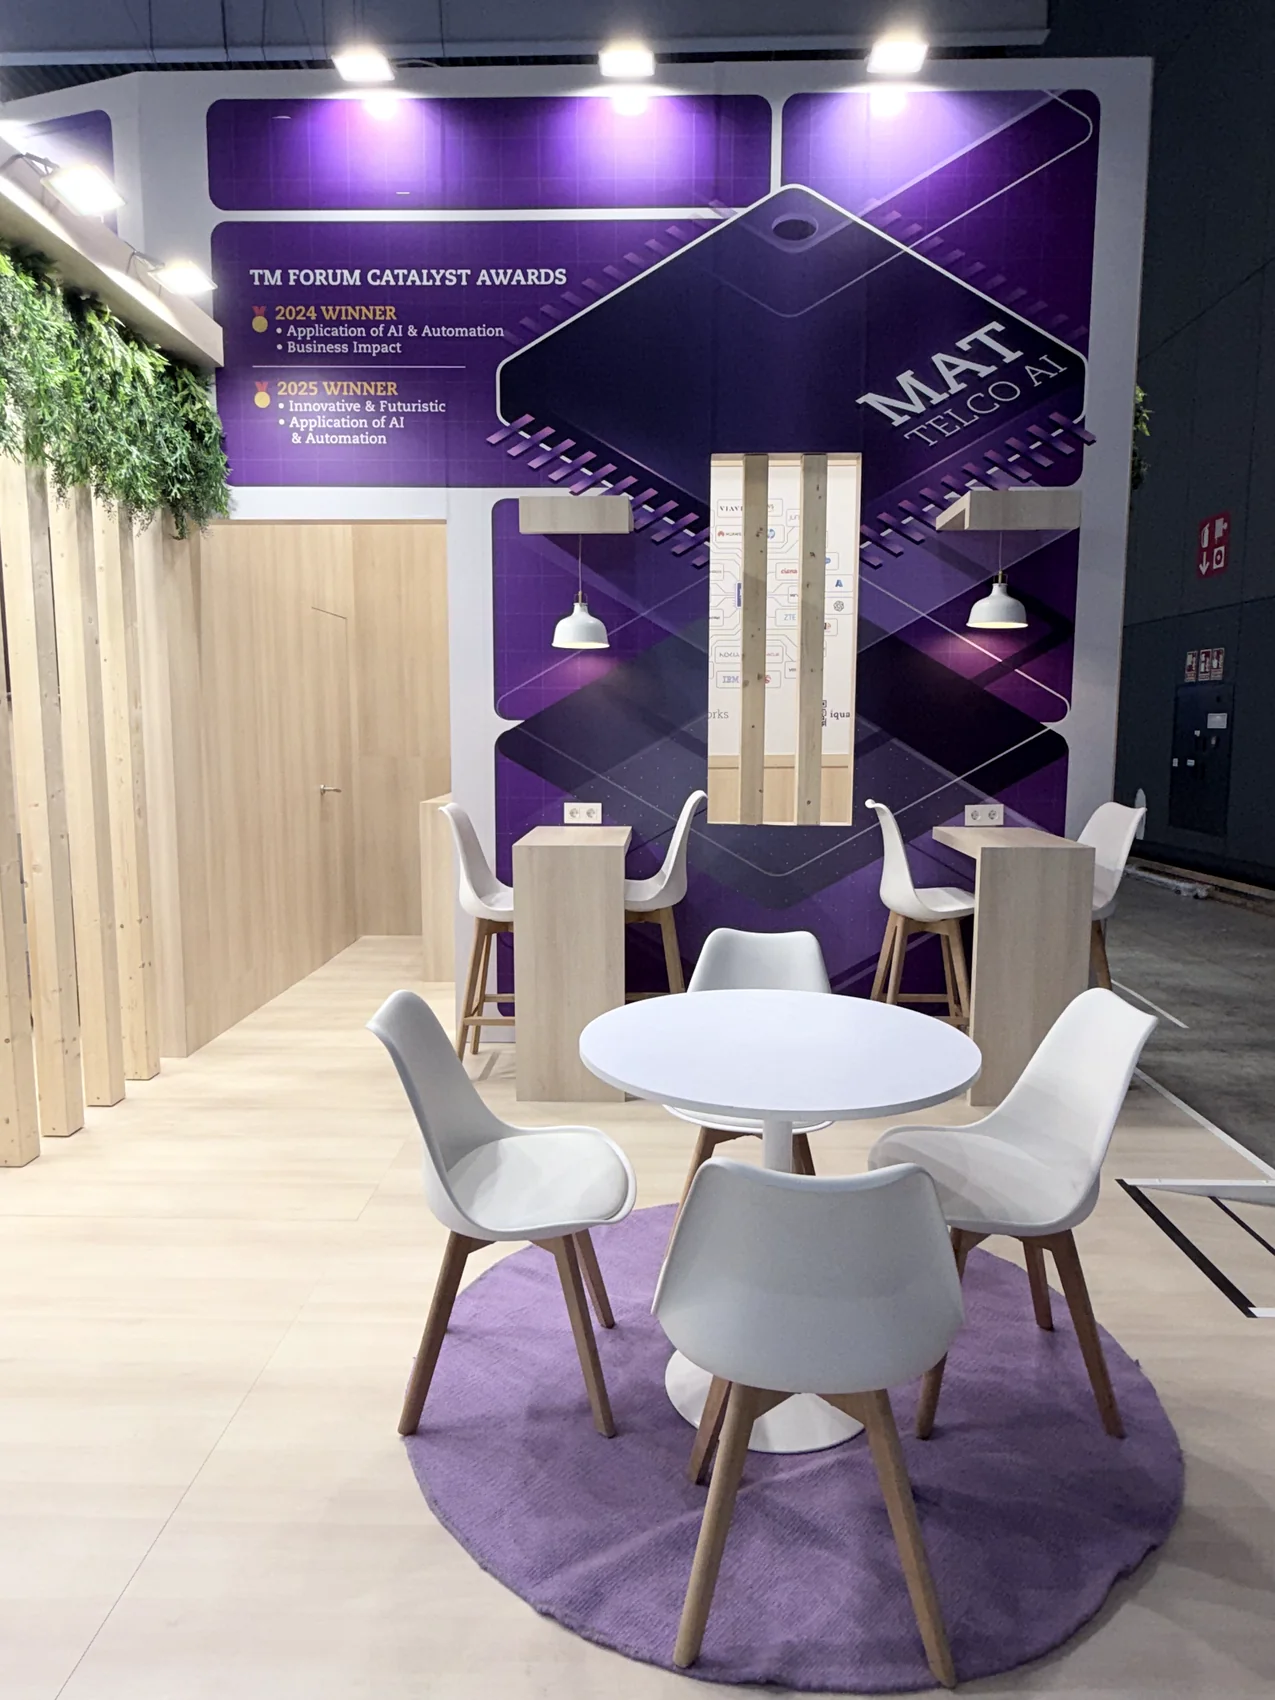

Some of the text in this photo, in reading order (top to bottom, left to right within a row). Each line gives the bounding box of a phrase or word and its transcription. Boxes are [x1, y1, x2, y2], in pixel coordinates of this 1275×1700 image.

[250, 268, 567, 286] TM FORUM CATALYST AWARDS
[275, 305, 397, 321] 2024 WINNER
[287, 324, 504, 341] Application of AI & Automation
[287, 341, 402, 357] Business Impact
[855, 320, 1024, 427] MAT
[277, 381, 398, 396] 2025 WINNER
[289, 400, 446, 413] Innovative & Futuristic
[903, 354, 1068, 447] TELCO AI
[289, 416, 404, 432] Application of AI
[291, 432, 387, 445] & Automation
[722, 675, 739, 683] IBM
